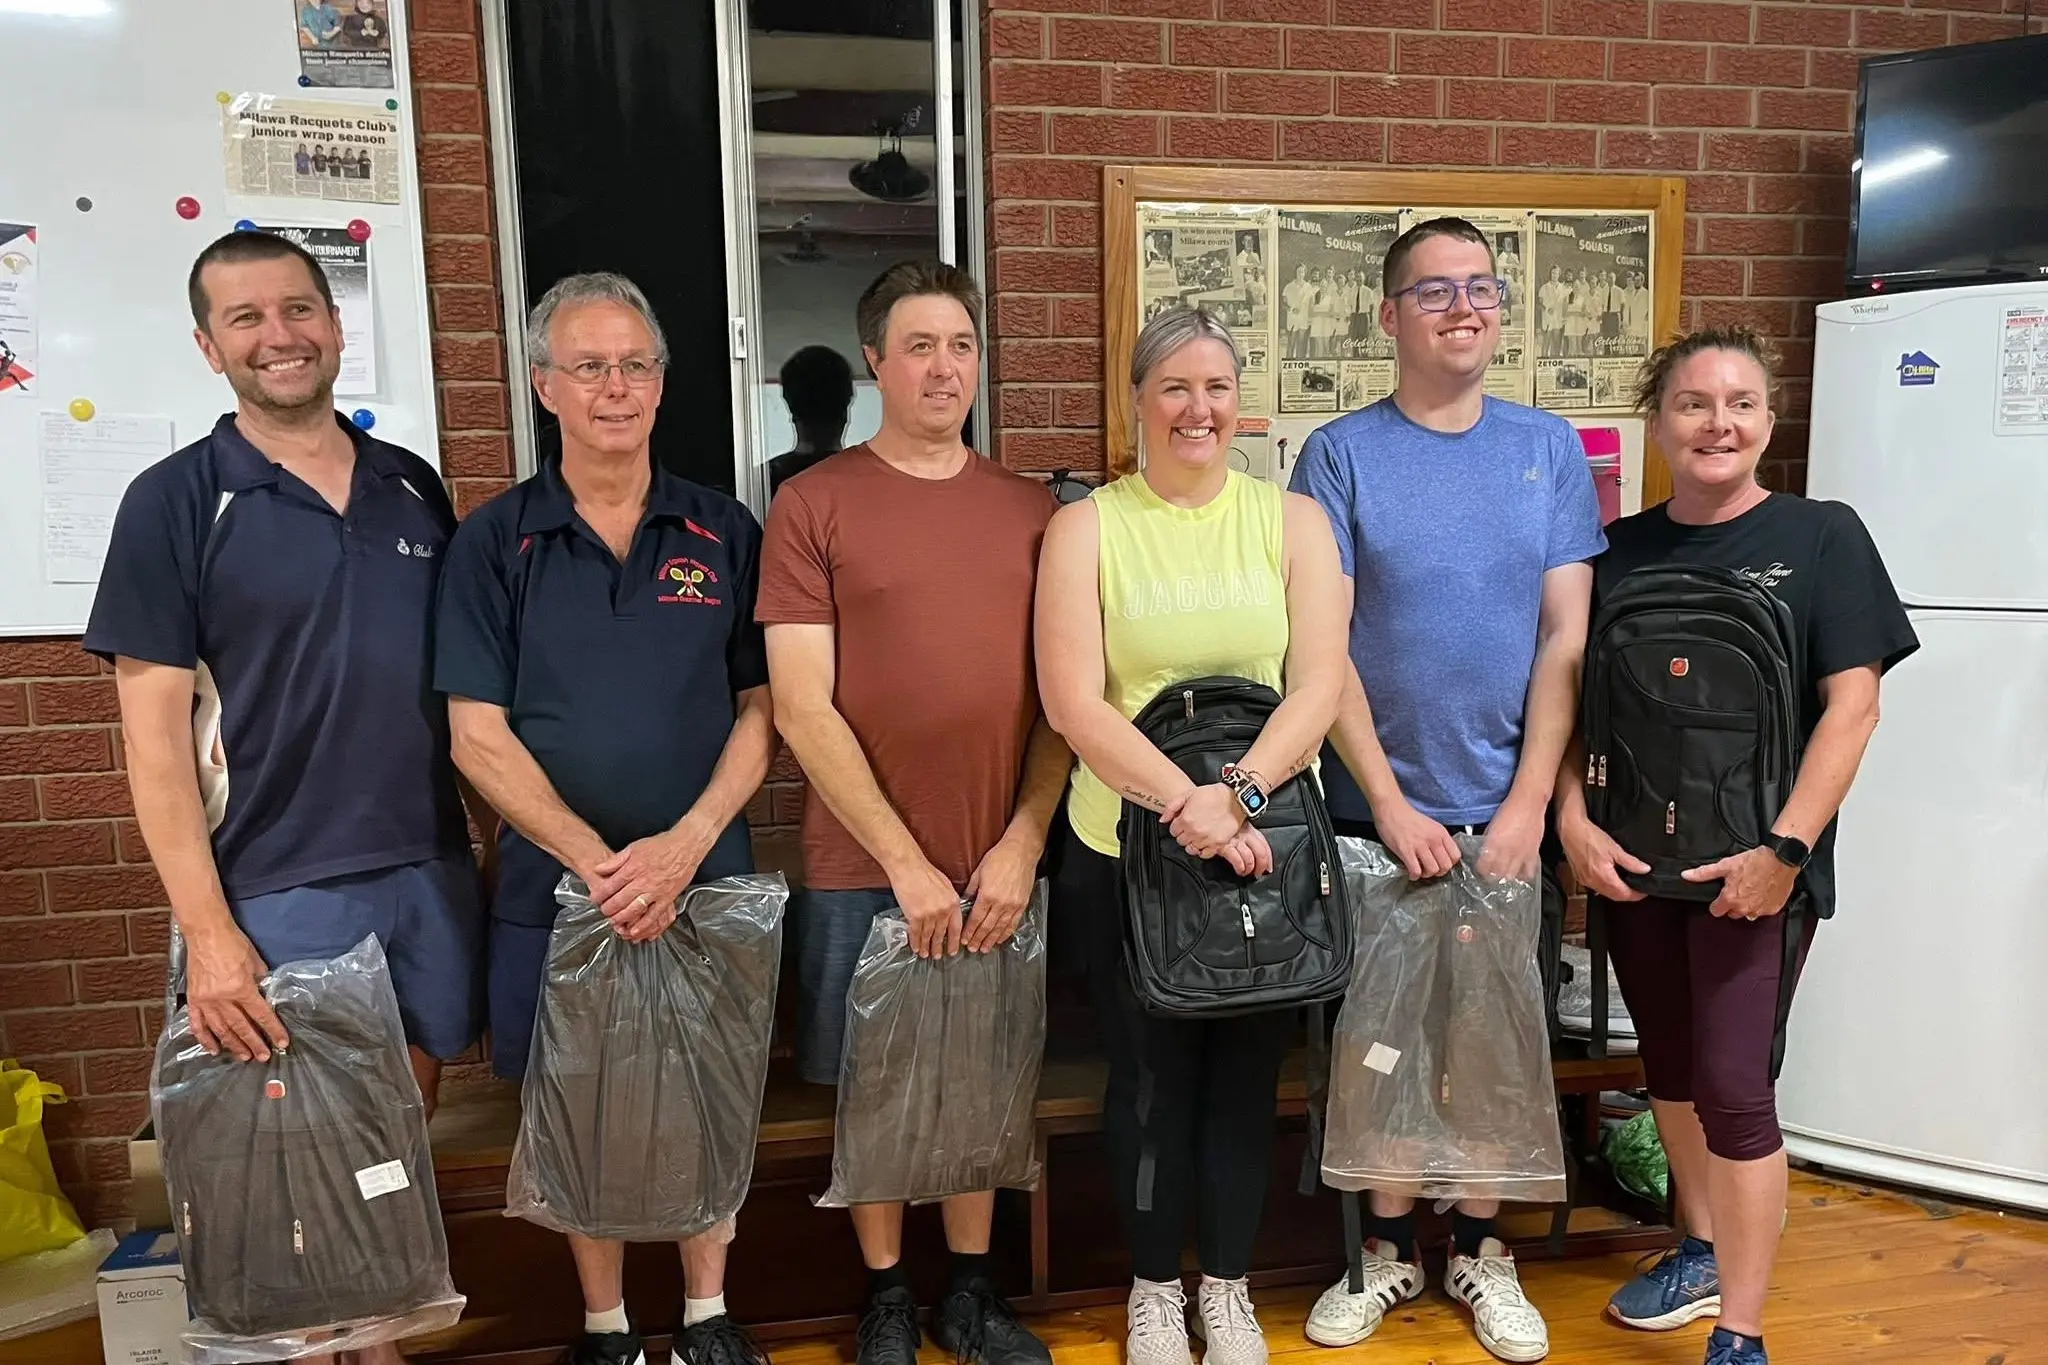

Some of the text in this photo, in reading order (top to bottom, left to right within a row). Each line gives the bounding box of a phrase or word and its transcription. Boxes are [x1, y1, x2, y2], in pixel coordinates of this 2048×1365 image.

[240, 111, 397, 133] Milawa Racquets Club's
[251, 126, 386, 145] juniors wrap season
[1535, 219, 1577, 239] MILAWA
[315, 244, 360, 257] TOURNAMENT
[1325, 236, 1364, 254] SQUASH
[1579, 239, 1615, 254] SQUASH
[1537, 360, 1563, 368] ZETOR
[116, 1287, 164, 1300] Arcoroc
